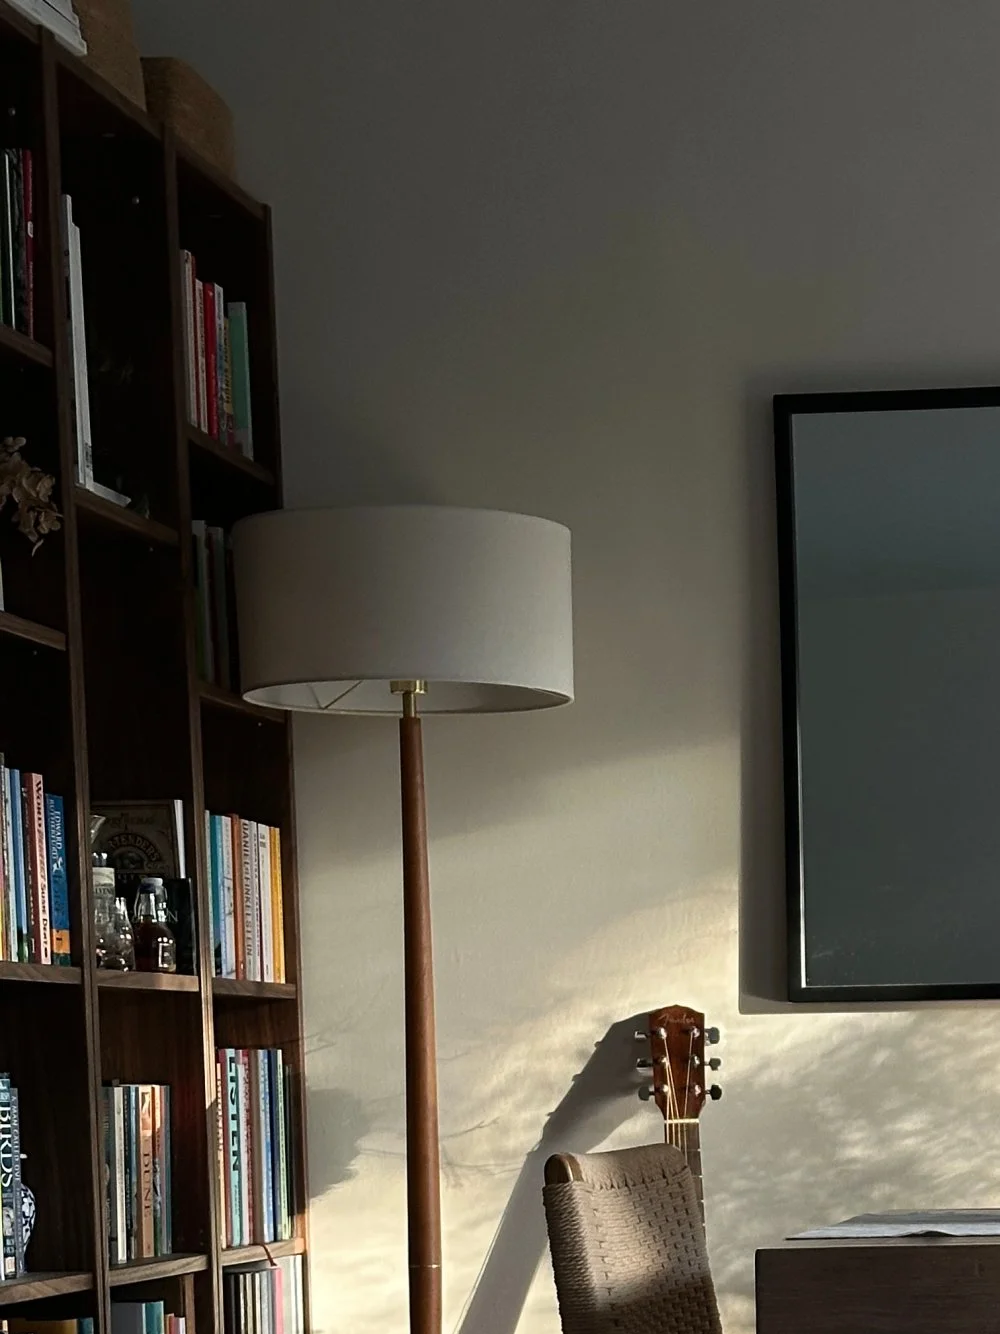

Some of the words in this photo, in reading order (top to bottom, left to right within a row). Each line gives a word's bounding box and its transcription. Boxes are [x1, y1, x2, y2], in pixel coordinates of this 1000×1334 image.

[35, 780, 43, 828] WORD
[55, 810, 63, 850] EDWARD
[229, 1056, 240, 1172] LISTEN
[143, 1153, 152, 1218] DUNE
